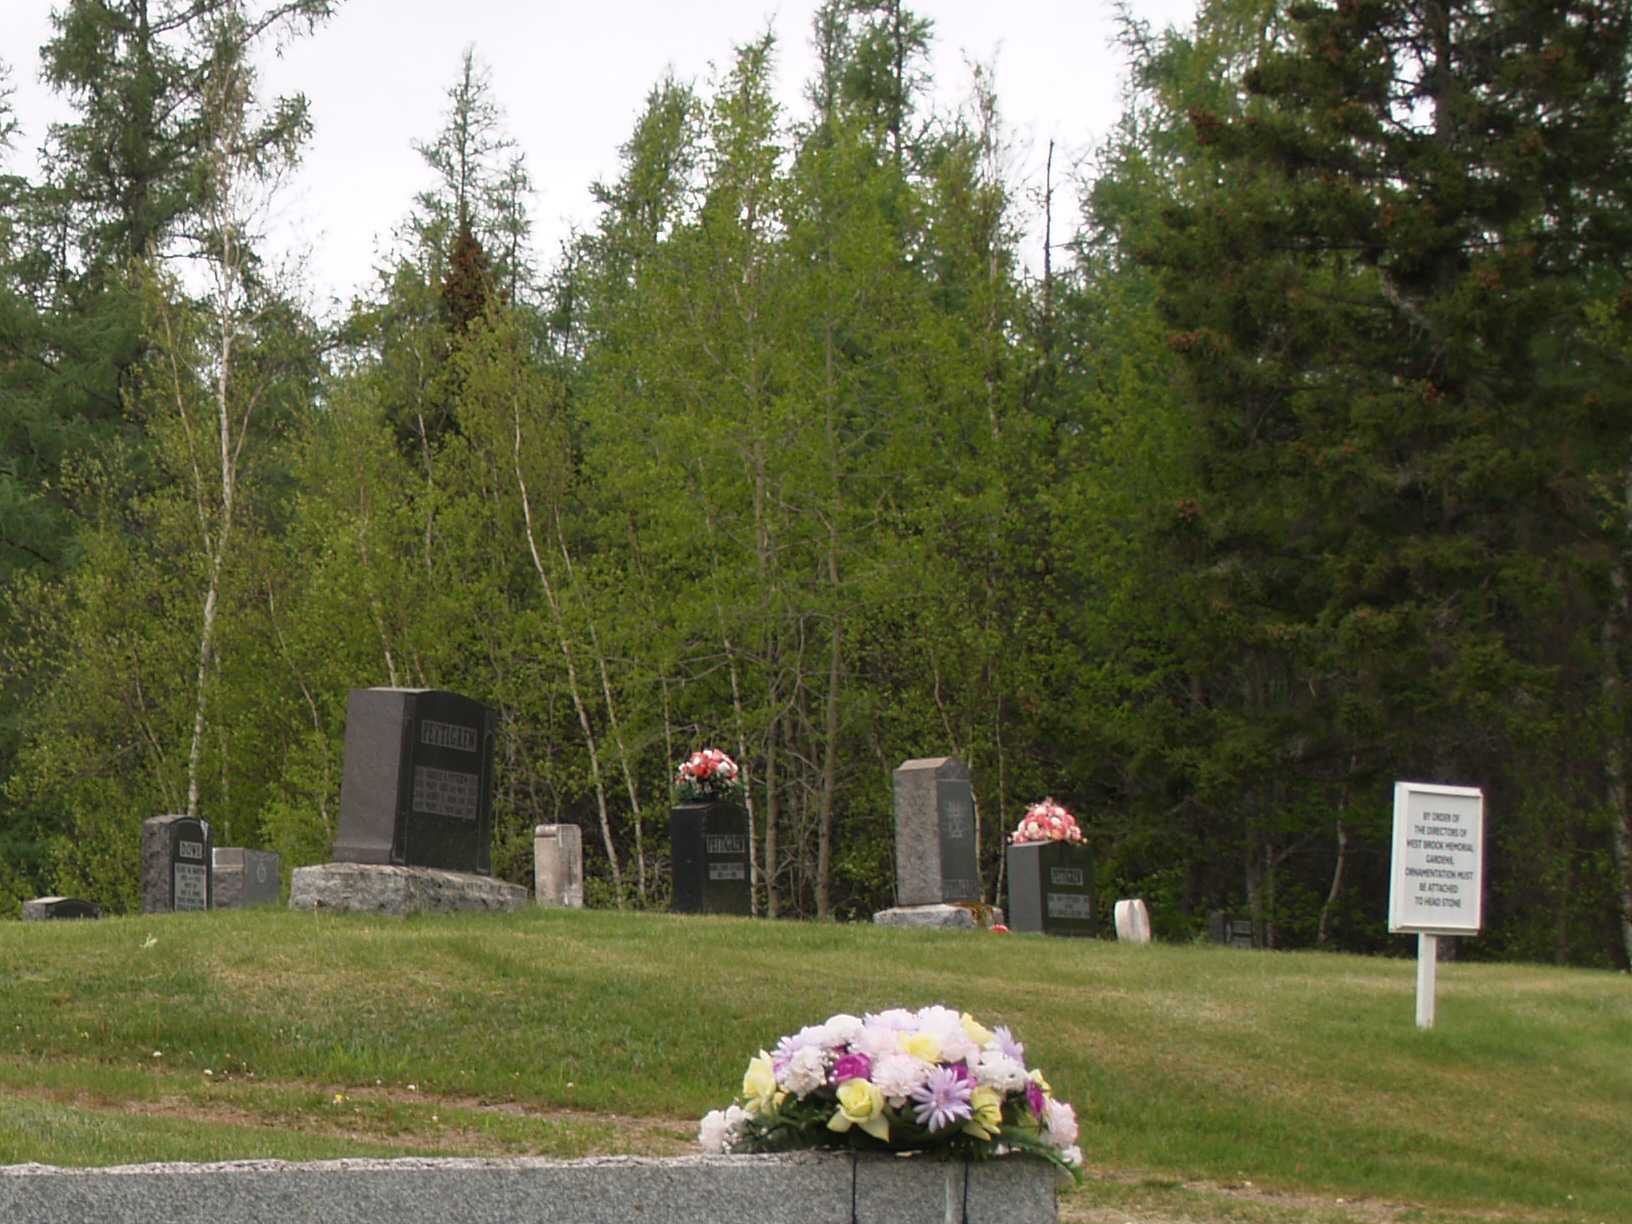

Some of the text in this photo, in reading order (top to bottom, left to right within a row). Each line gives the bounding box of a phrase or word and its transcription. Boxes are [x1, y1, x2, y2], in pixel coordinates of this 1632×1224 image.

[1431, 812, 1451, 822] ORDER
[1452, 814, 1460, 823] OF
[1414, 824, 1467, 838] THE DIRECTORS OF
[1407, 839, 1473, 853] WEST BROOK MEMORIAL
[1405, 867, 1474, 880] ORNAMENTATION MUST
[1419, 882, 1459, 893] BE ATTACHED
[1414, 896, 1423, 905] TO
[1424, 897, 1442, 907] HEAD
